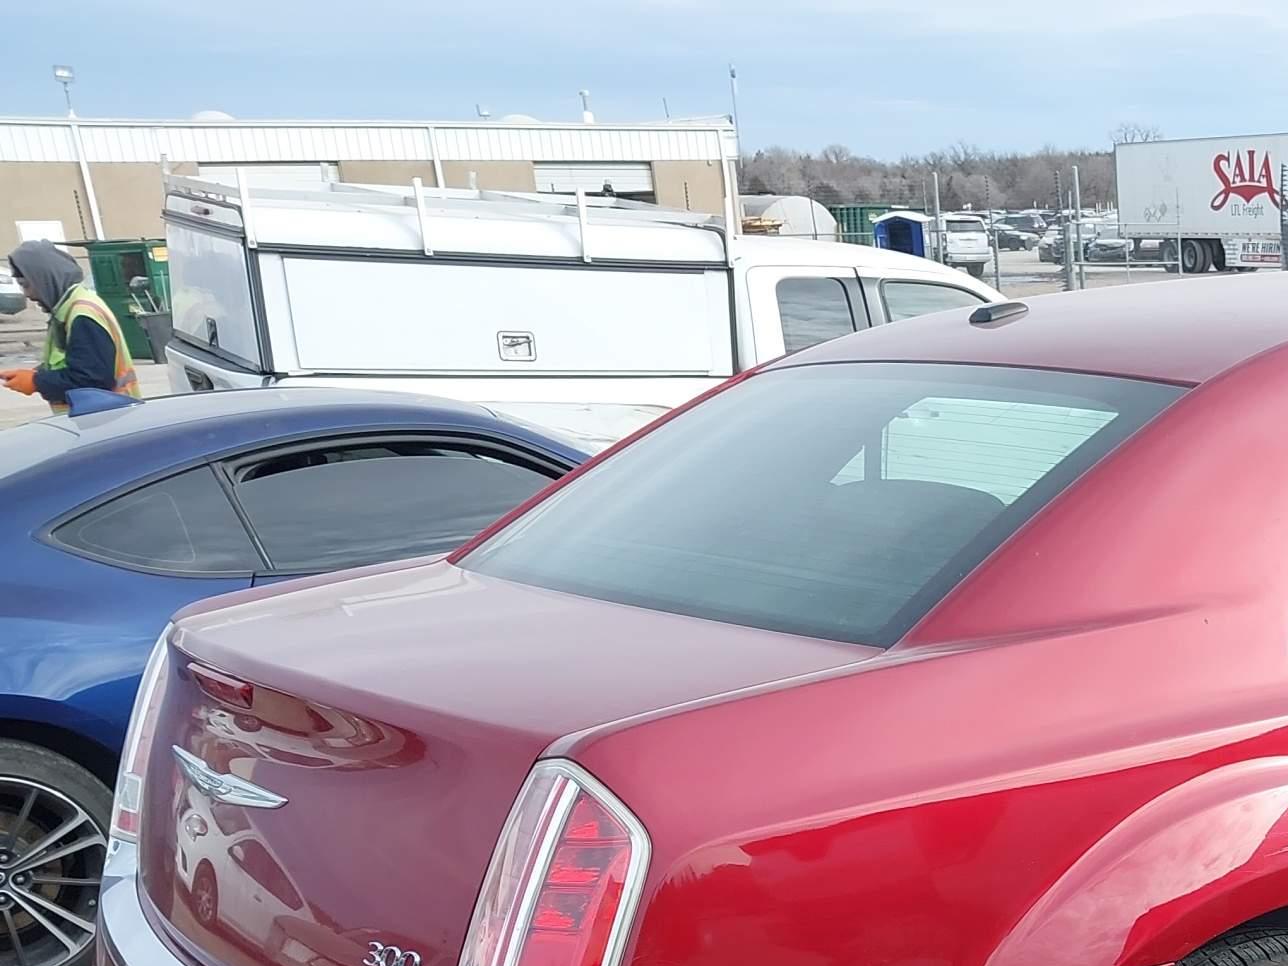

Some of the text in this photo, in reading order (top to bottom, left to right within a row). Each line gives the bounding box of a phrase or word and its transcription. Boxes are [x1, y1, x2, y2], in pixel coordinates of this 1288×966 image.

[1210, 149, 1288, 211] SAIA
[1242, 204, 1264, 218] Freight
[1261, 242, 1281, 254] HIRIN
